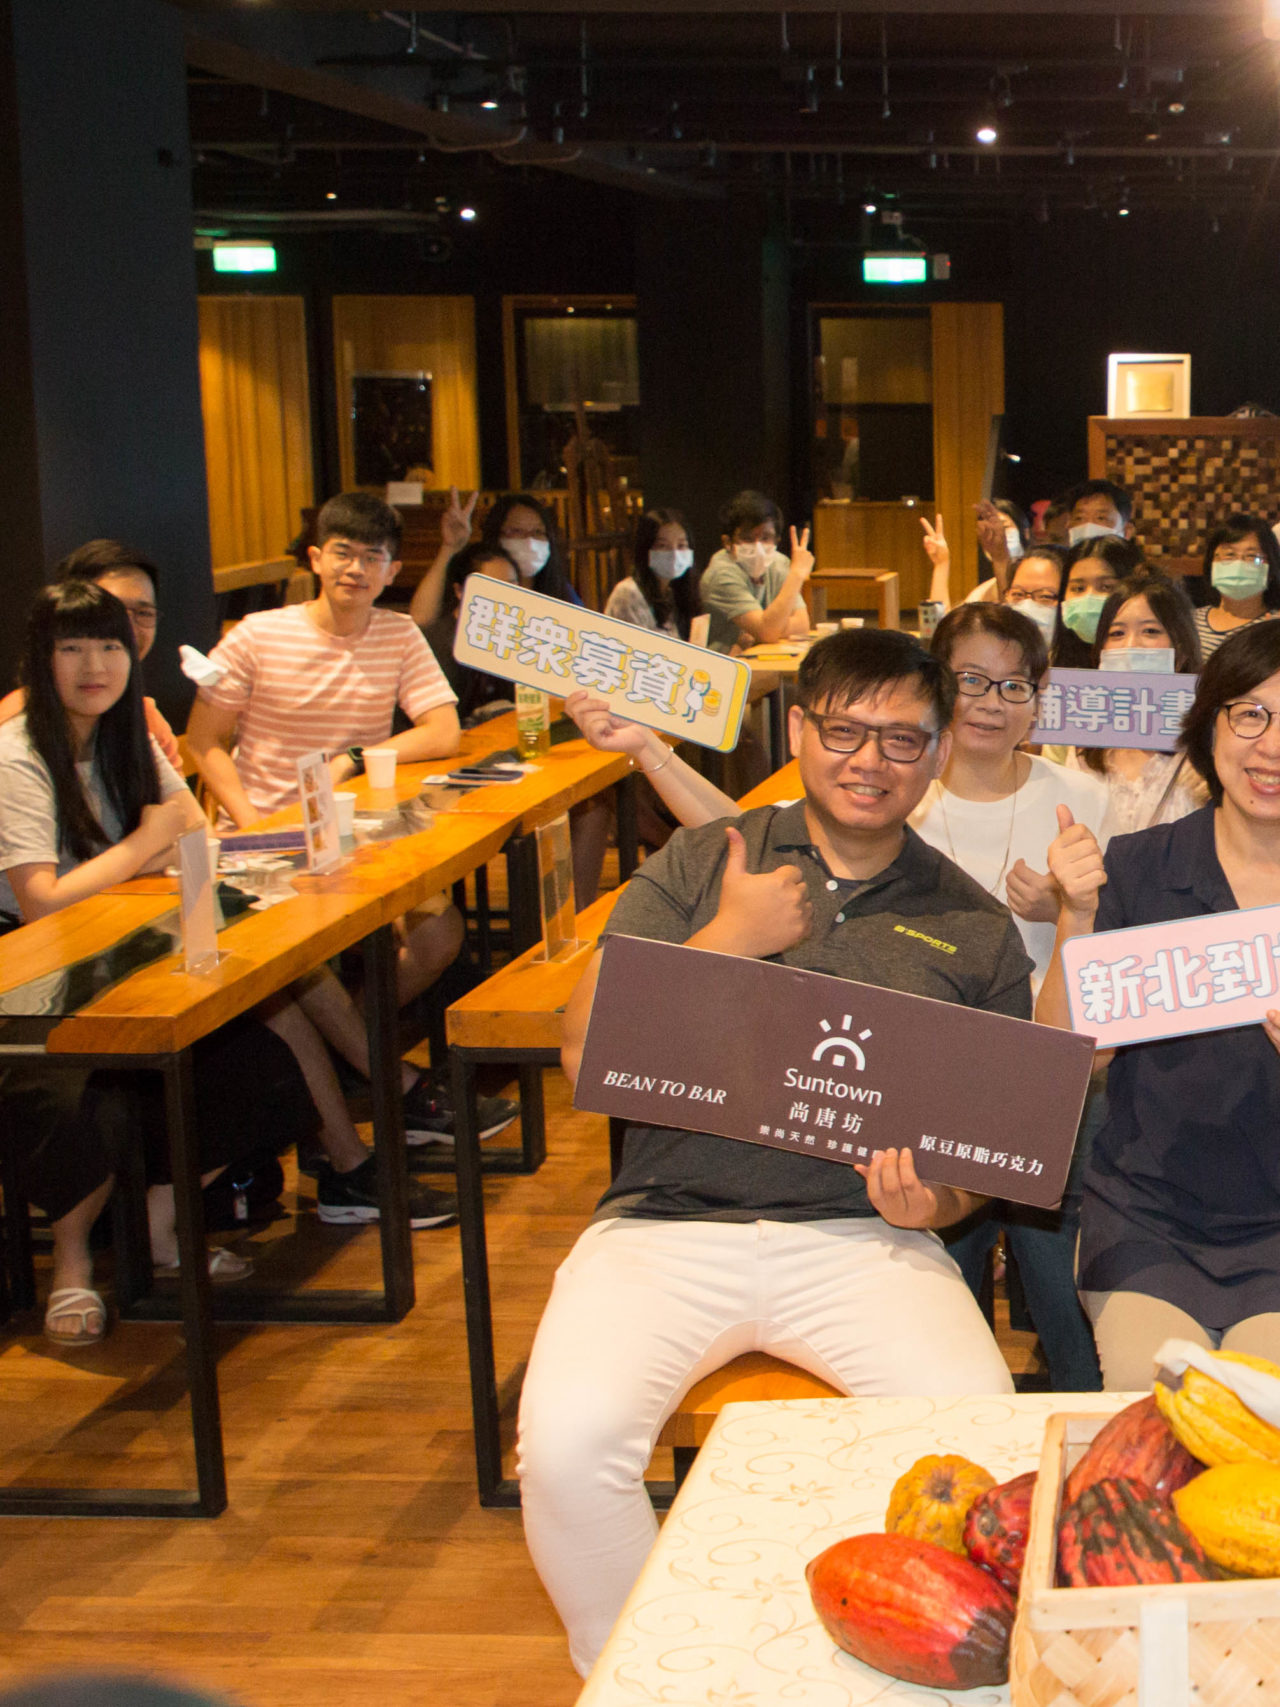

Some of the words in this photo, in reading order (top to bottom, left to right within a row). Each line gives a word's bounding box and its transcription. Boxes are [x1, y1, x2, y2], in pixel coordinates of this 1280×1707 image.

[603, 1070, 656, 1092] BEAN
[659, 1079, 686, 1097] TO
[688, 1085, 727, 1105] BAR
[783, 1067, 883, 1107] Suntown
[788, 1101, 864, 1134] 尚唐坊
[918, 1134, 1044, 1176] 原豆原脂巧克力
